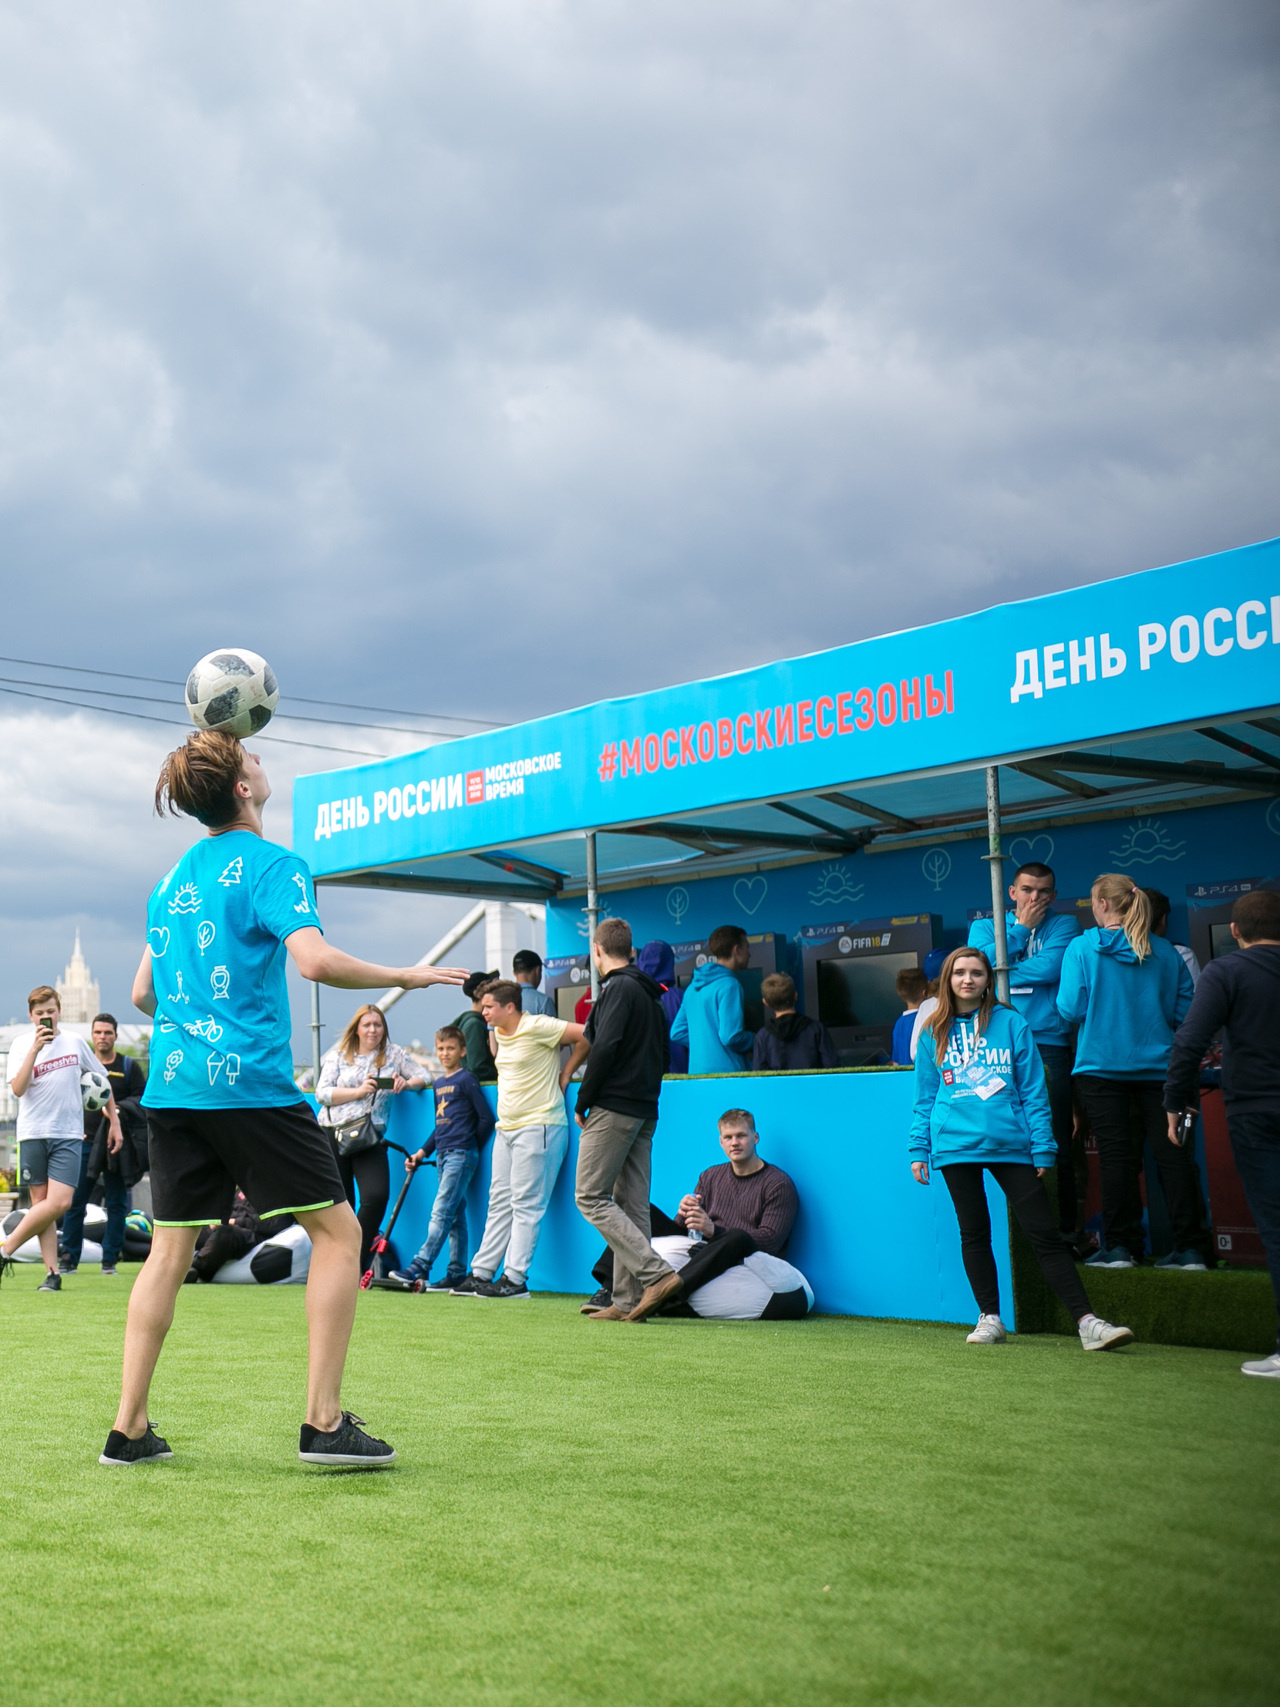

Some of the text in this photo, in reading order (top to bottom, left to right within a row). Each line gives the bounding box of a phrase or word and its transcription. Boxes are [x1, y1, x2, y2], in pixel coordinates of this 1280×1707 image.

[1010, 595, 1280, 704] ДЕНЬ РОСС
[598, 670, 955, 782] #МОСКОВСКИЕСЕЗОНЫ
[485, 752, 562, 783] МОСКОВСКОЕ
[485, 777, 524, 801] ВРЕМЯ
[314, 773, 463, 841] ДЕНЬ РОССИИ
